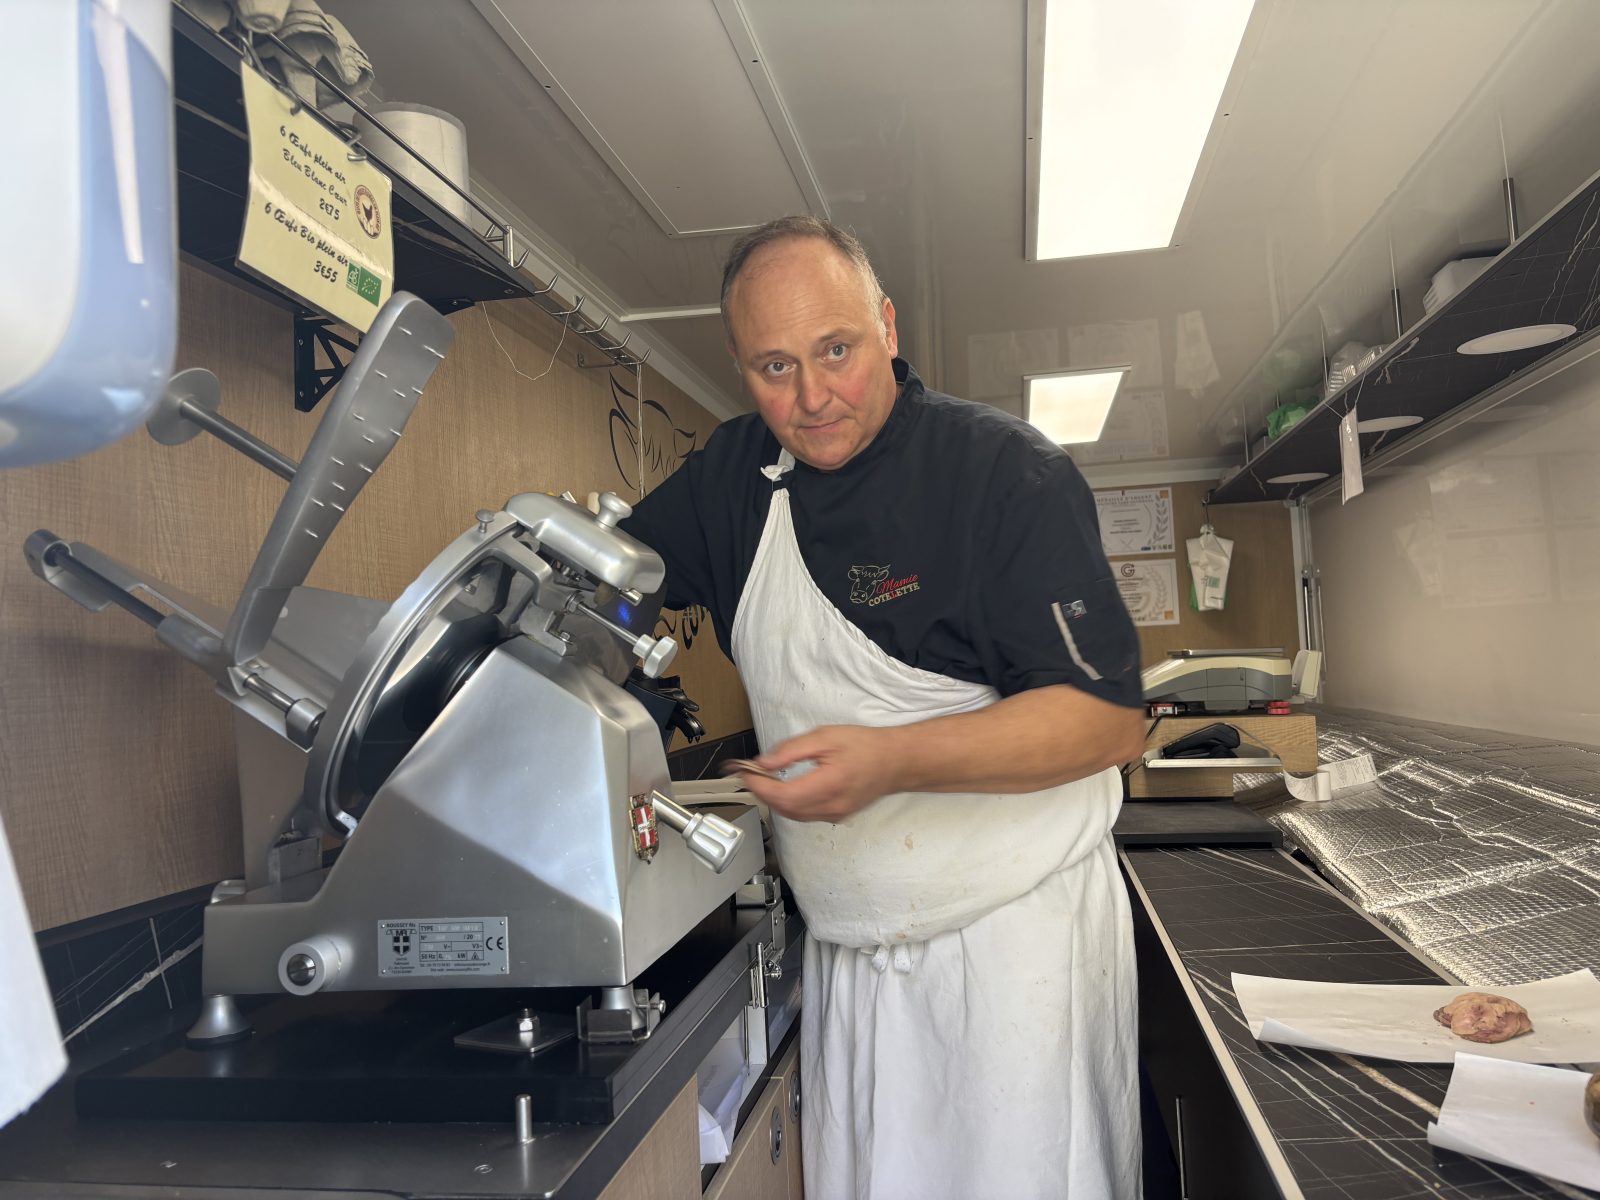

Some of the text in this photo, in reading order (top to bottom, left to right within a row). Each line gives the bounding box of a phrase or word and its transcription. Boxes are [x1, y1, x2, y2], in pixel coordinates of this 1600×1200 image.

[280, 125, 286, 137] 6
[313, 153, 333, 174] plein
[334, 171, 346, 184] air
[283, 148, 302, 172] Bleu
[304, 165, 327, 190] Blanc
[319, 197, 340, 220] 2€75
[264, 202, 272, 214] 6
[300, 225, 315, 244] Bio
[315, 239, 335, 258] plein
[337, 254, 348, 267] air
[313, 260, 338, 283] 3€55
[868, 582, 920, 607] COTELETTE
[876, 574, 919, 594] Mamie
[485, 936, 505, 951] CE
